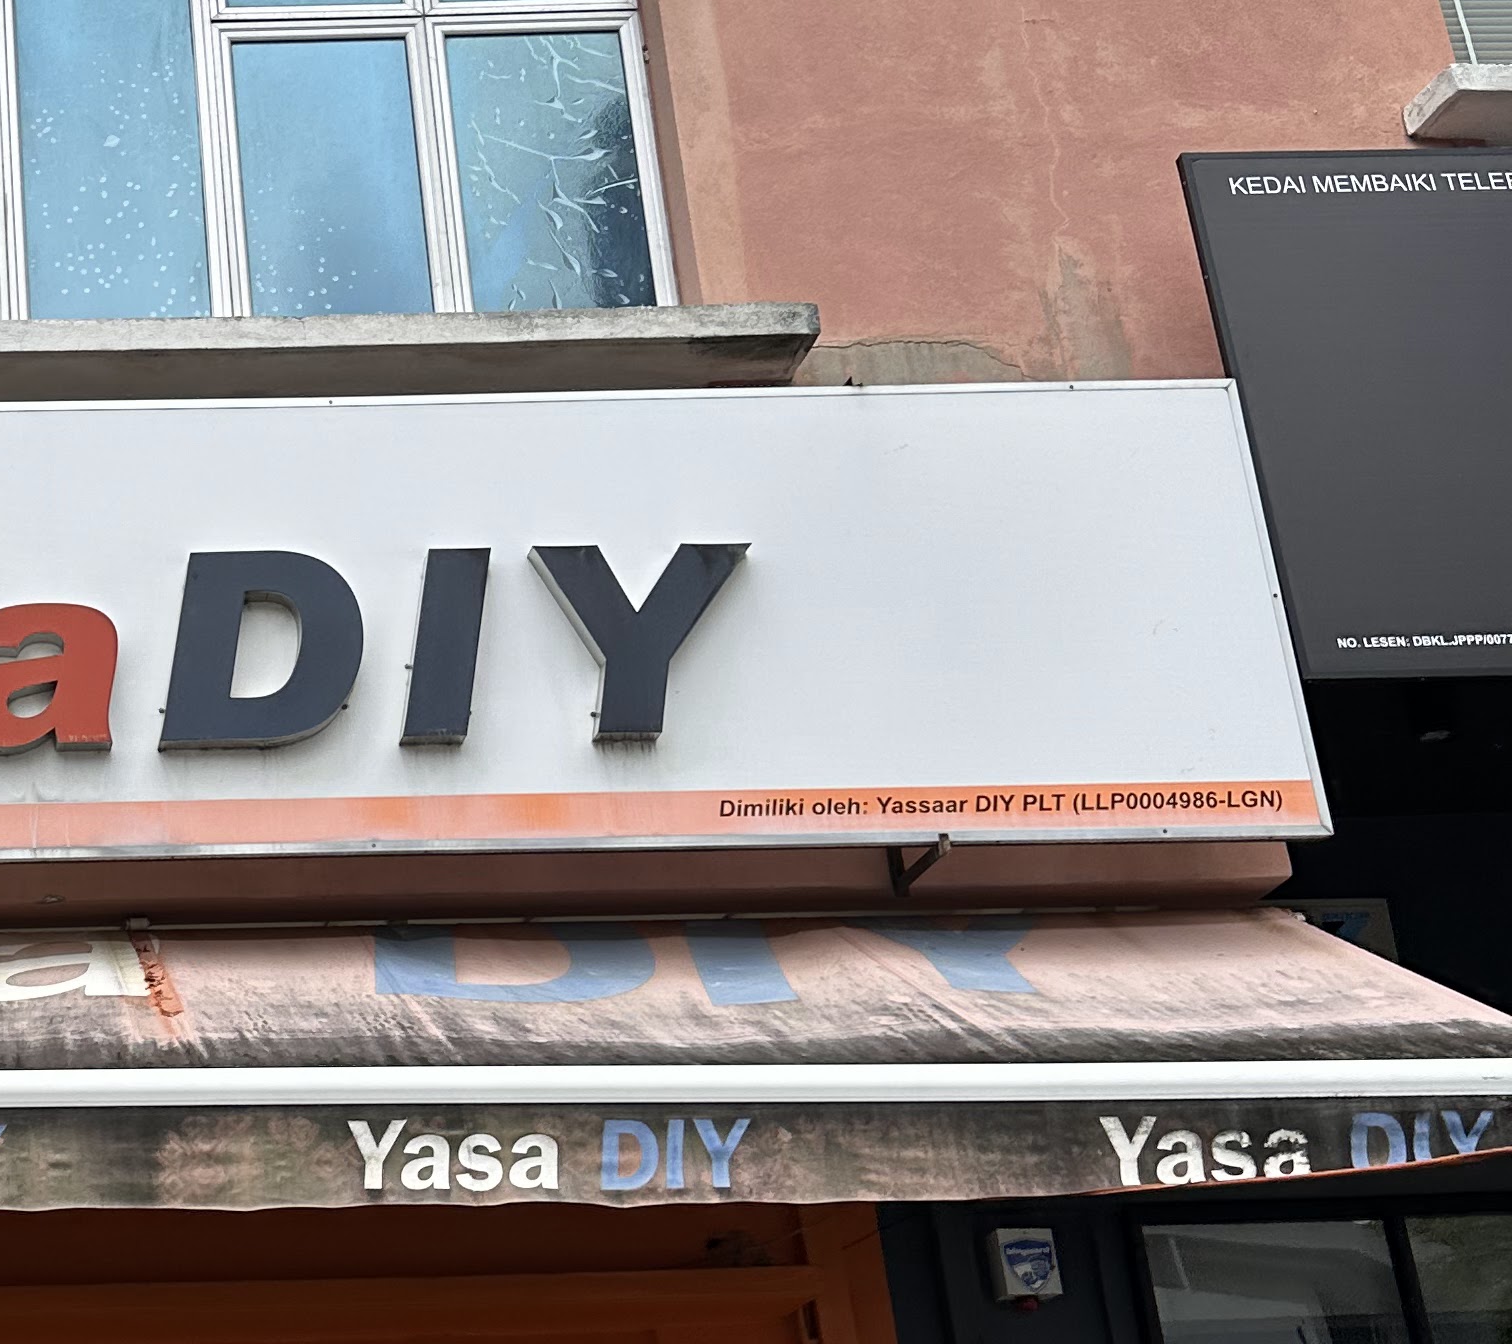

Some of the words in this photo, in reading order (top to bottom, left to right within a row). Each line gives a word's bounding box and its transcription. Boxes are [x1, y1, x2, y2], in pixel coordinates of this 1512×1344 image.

[1228, 175, 1306, 195] KEDAI
[1312, 173, 1437, 193] MEMBAIKI
[158, 542, 752, 752] DIY
[1336, 637, 1362, 648] NO.
[1363, 636, 1411, 648] LESEN:
[719, 797, 806, 818] Dimiliki
[811, 797, 869, 816] oleh:
[877, 796, 968, 815] Yassaar
[975, 795, 1015, 814] DIY
[1022, 794, 1066, 813] PLT
[1072, 790, 1284, 814] (LLP0004986-LGN)
[373, 920, 1037, 1007] DIY
[345, 1117, 561, 1193] Yasa
[599, 1117, 753, 1191] DIY
[1098, 1115, 1312, 1188] Yasa
[1350, 1109, 1496, 1169] DIY
